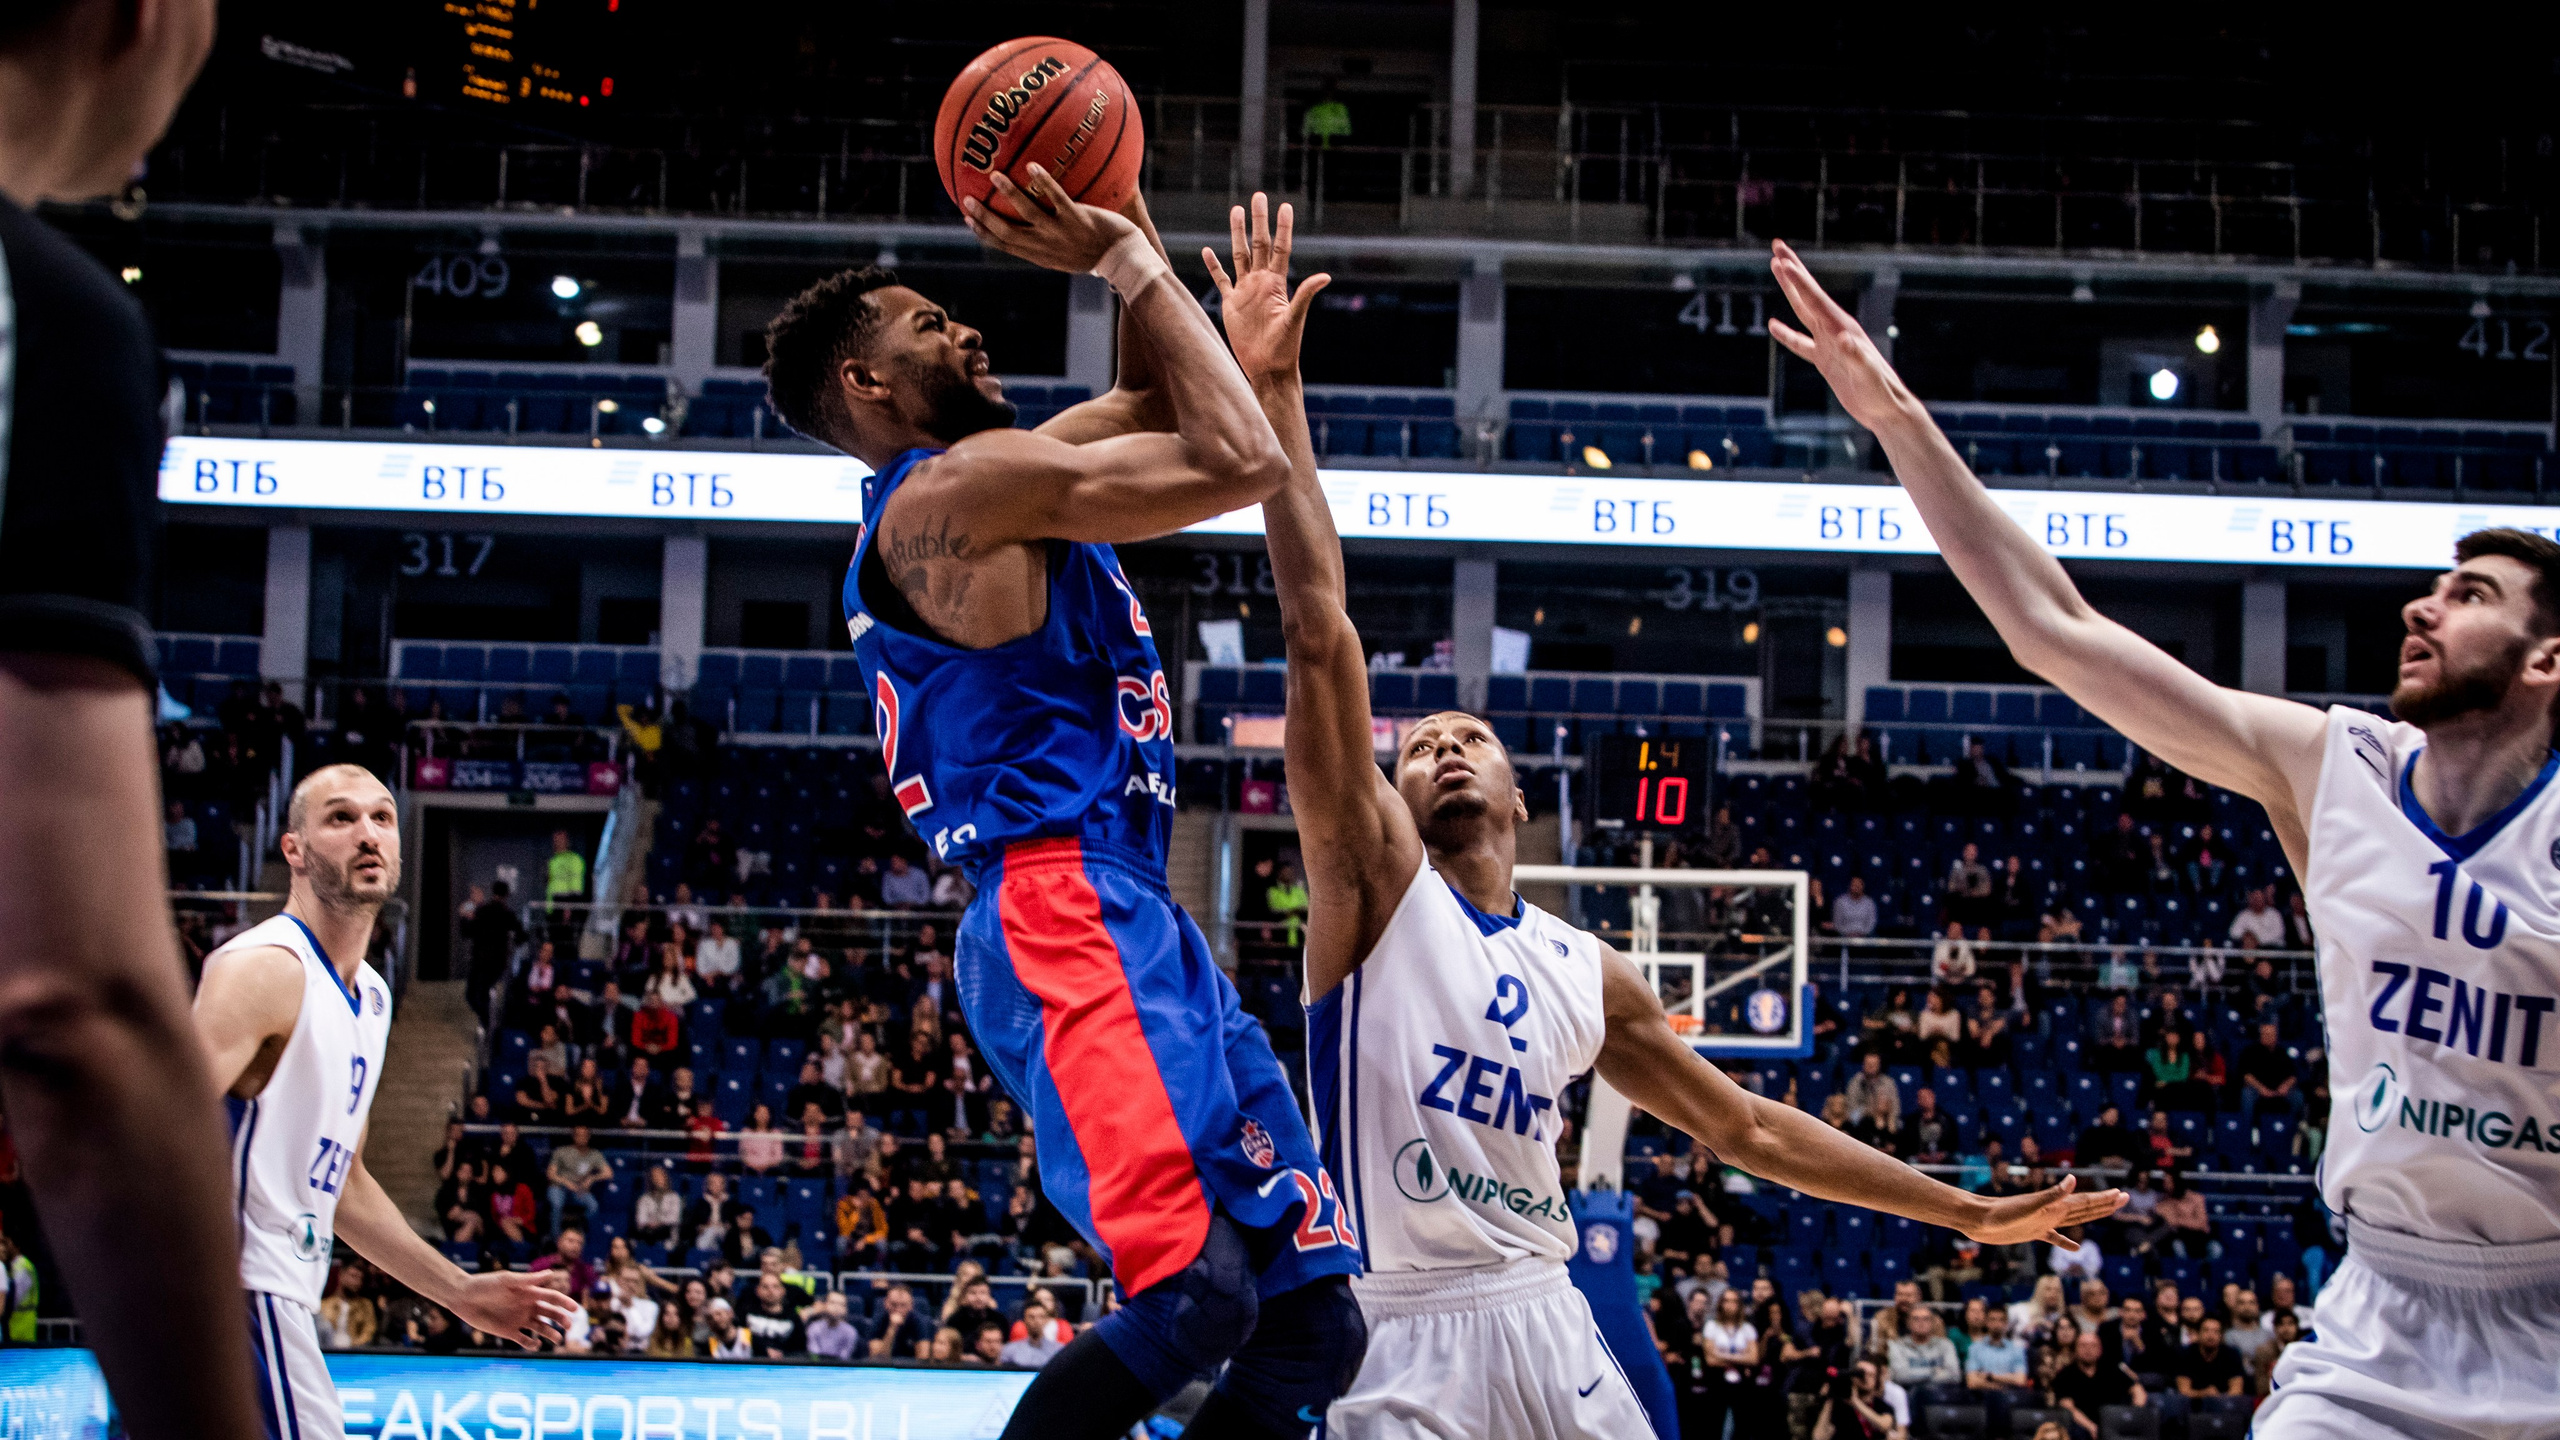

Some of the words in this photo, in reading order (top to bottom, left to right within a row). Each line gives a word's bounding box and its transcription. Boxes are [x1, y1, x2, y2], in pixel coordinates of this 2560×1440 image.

[960, 54, 1072, 175] Wilson
[414, 257, 510, 298] 409
[1678, 290, 1769, 335] 411
[2458, 317, 2551, 360] 412
[194, 458, 279, 496] ВТБ
[422, 465, 506, 502] ВТБ
[651, 472, 735, 508] ВТБ
[1367, 492, 1451, 529] ВТБ
[1593, 499, 1677, 535] ВТБ
[1820, 505, 1903, 541] ВТБ
[2046, 512, 2129, 548] ВТБ
[400, 533, 496, 577] 317
[2270, 519, 2354, 556] ВТБ
[1662, 567, 1760, 612] 319
[1116, 669, 1175, 743] CS
[1638, 741, 1680, 771] 1.4
[1635, 776, 1689, 825] 10
[2427, 858, 2509, 950] 10
[1484, 973, 1529, 1054] 2
[2369, 958, 2555, 1068] ZENIT
[2399, 1095, 2560, 1155] NIPIGAS
[1292, 1166, 1360, 1253] 22
[1447, 1166, 1570, 1223] NIPIGAS
